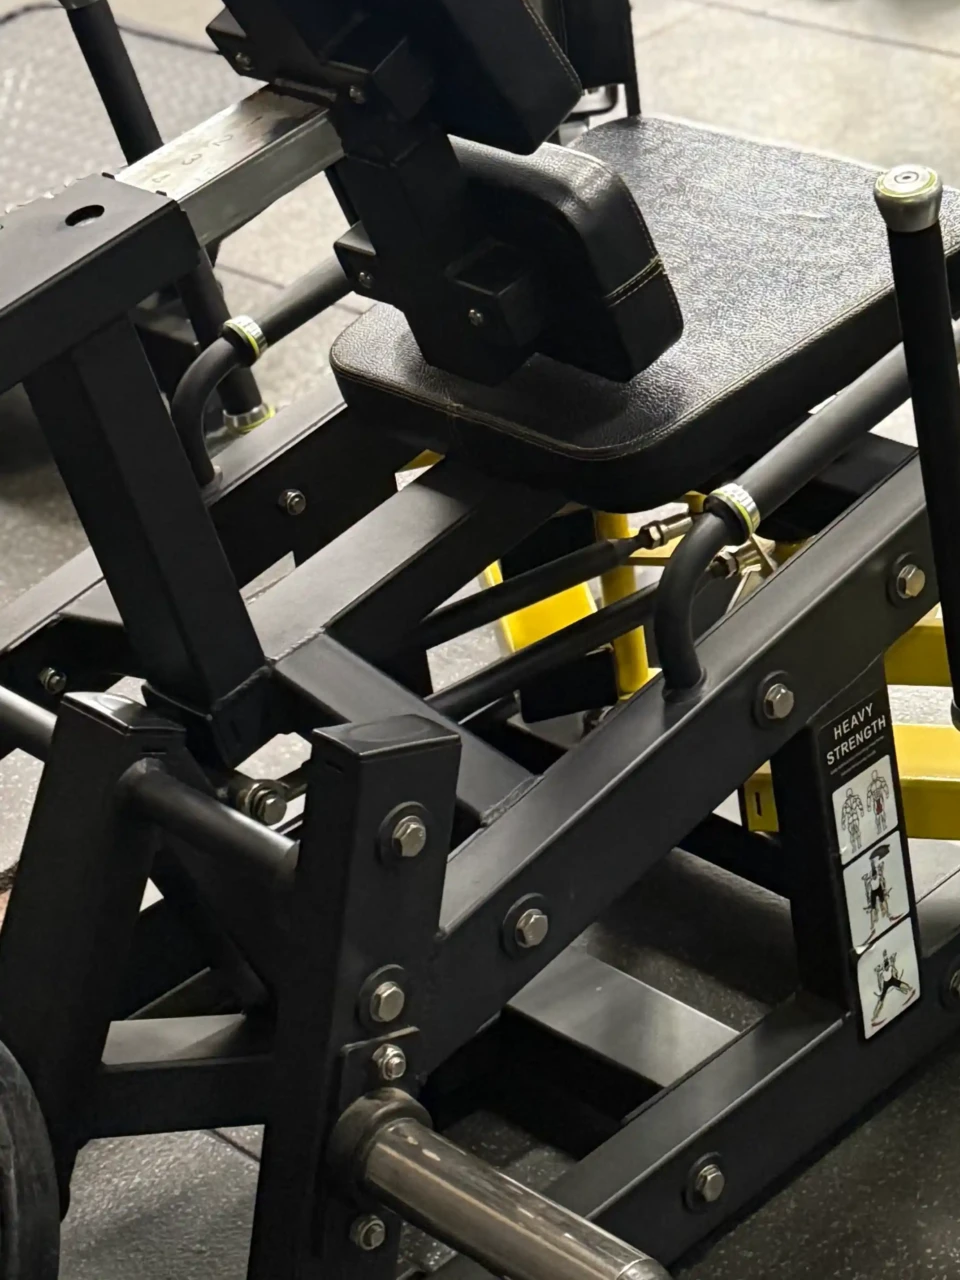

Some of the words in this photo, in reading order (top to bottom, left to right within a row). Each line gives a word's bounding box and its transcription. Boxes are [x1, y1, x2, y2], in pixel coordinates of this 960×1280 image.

[181, 152, 203, 167] 3
[826, 714, 887, 766] STRENGTH
[833, 702, 874, 741] HEAVY
